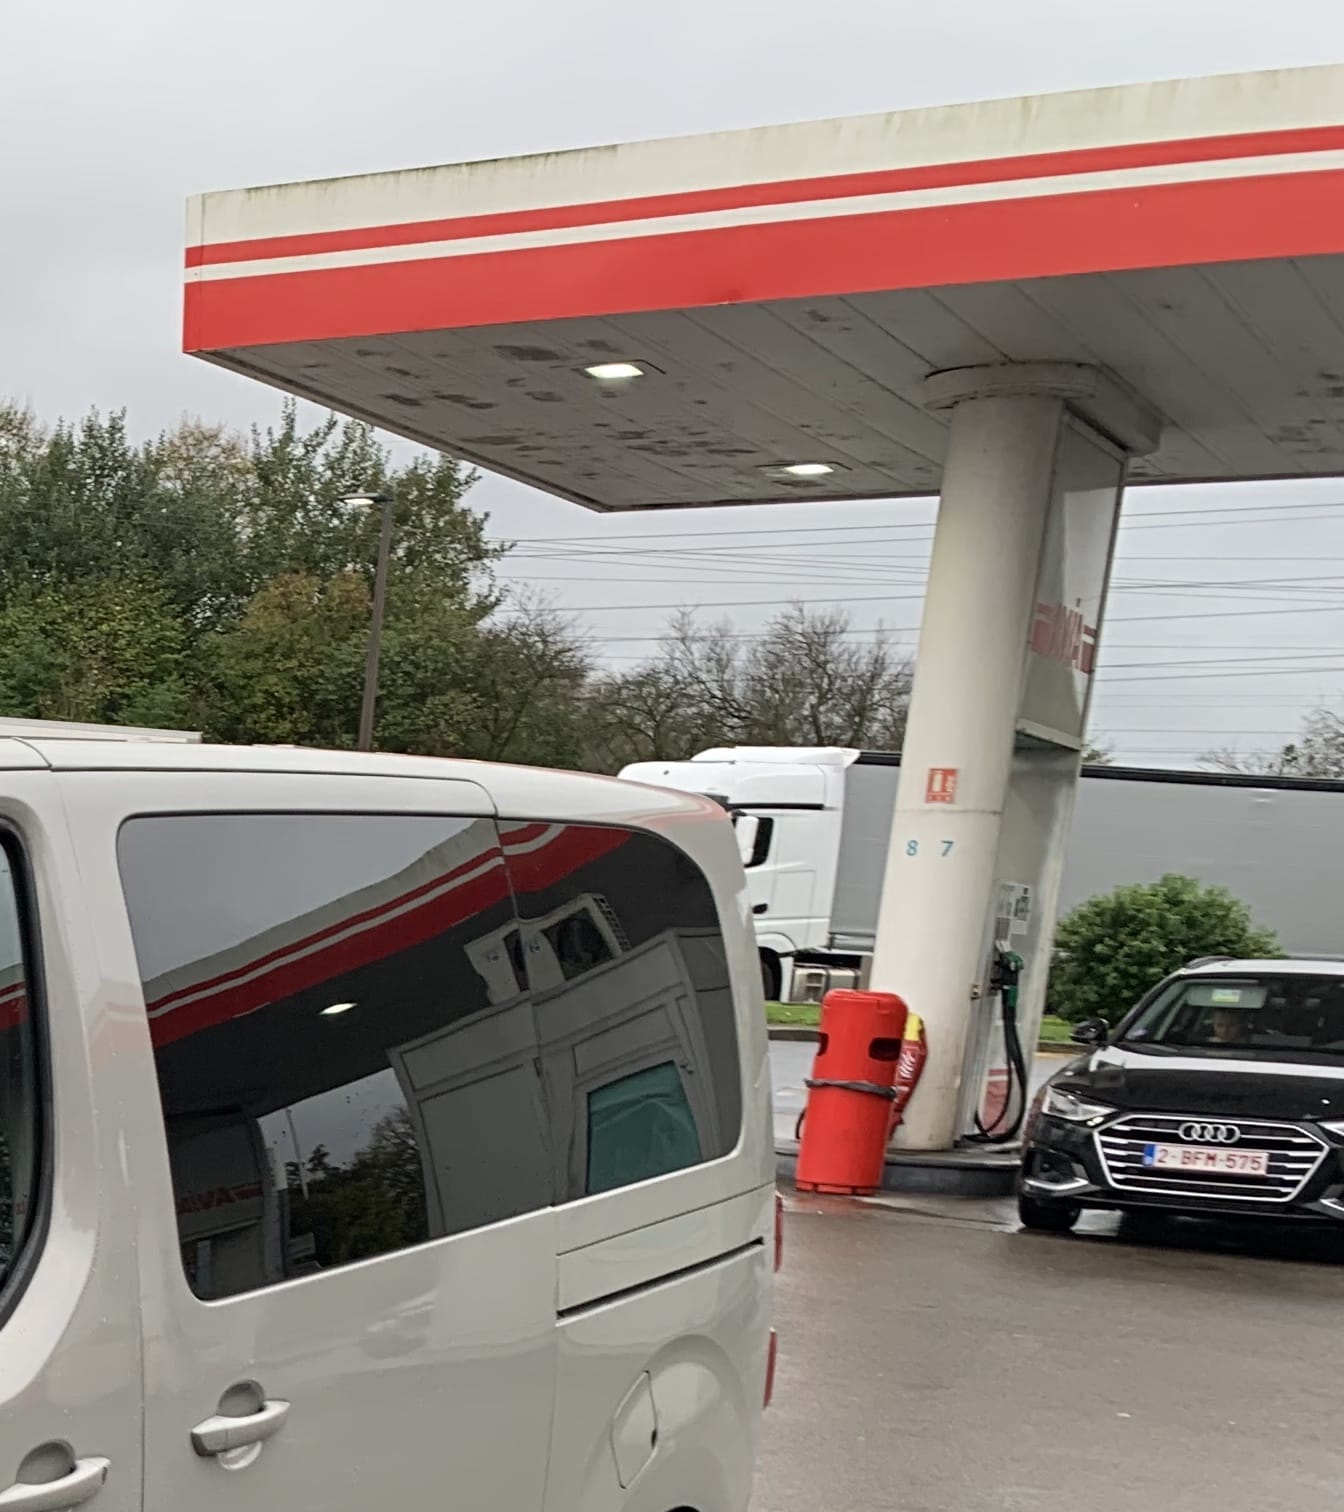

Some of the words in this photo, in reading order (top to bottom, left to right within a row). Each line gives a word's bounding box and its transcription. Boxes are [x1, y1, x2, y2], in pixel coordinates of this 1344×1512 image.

[906, 839, 919, 856] 8
[939, 840, 954, 856] 7
[1156, 1147, 1263, 1171] 2-BFM-575
